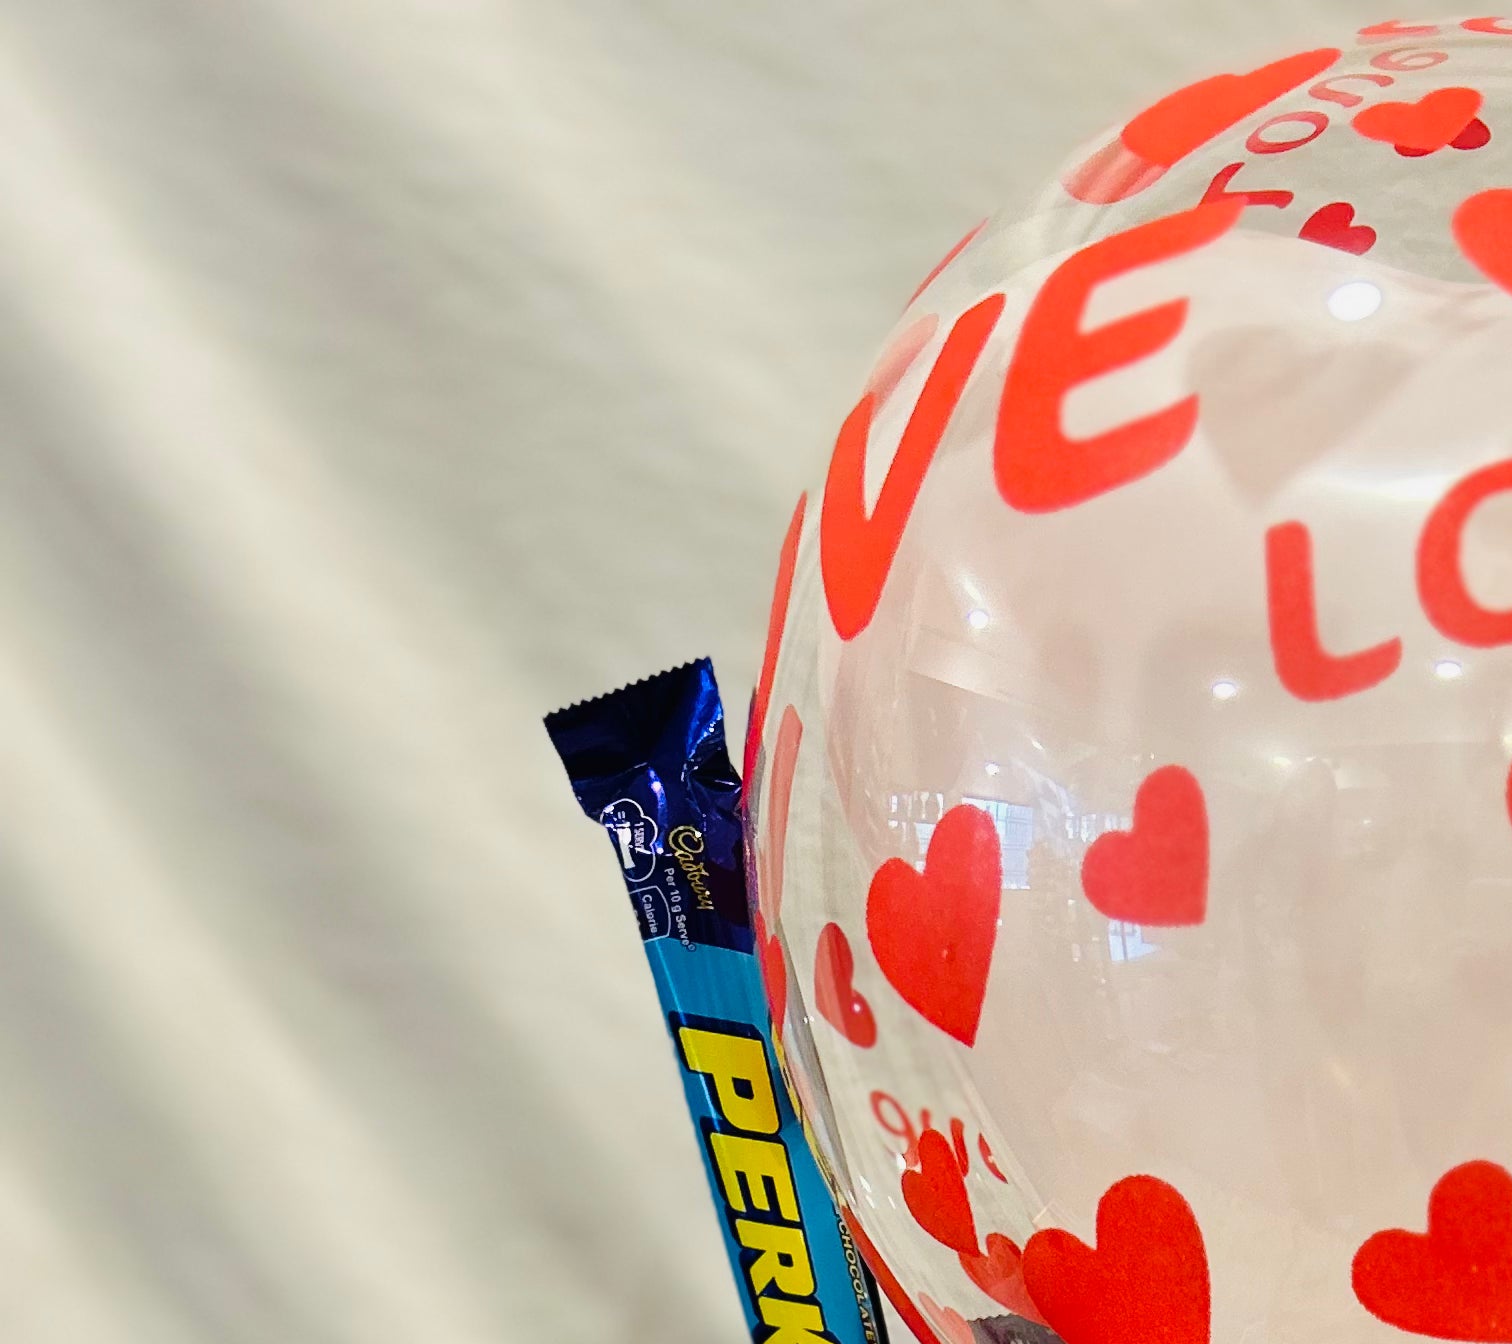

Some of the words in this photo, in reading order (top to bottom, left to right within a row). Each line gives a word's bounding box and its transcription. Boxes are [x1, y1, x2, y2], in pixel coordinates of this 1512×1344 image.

[819, 195, 1250, 642] VE
[664, 868, 676, 887] Per
[670, 890, 681, 903] 10
[668, 825, 714, 910] Cadbury
